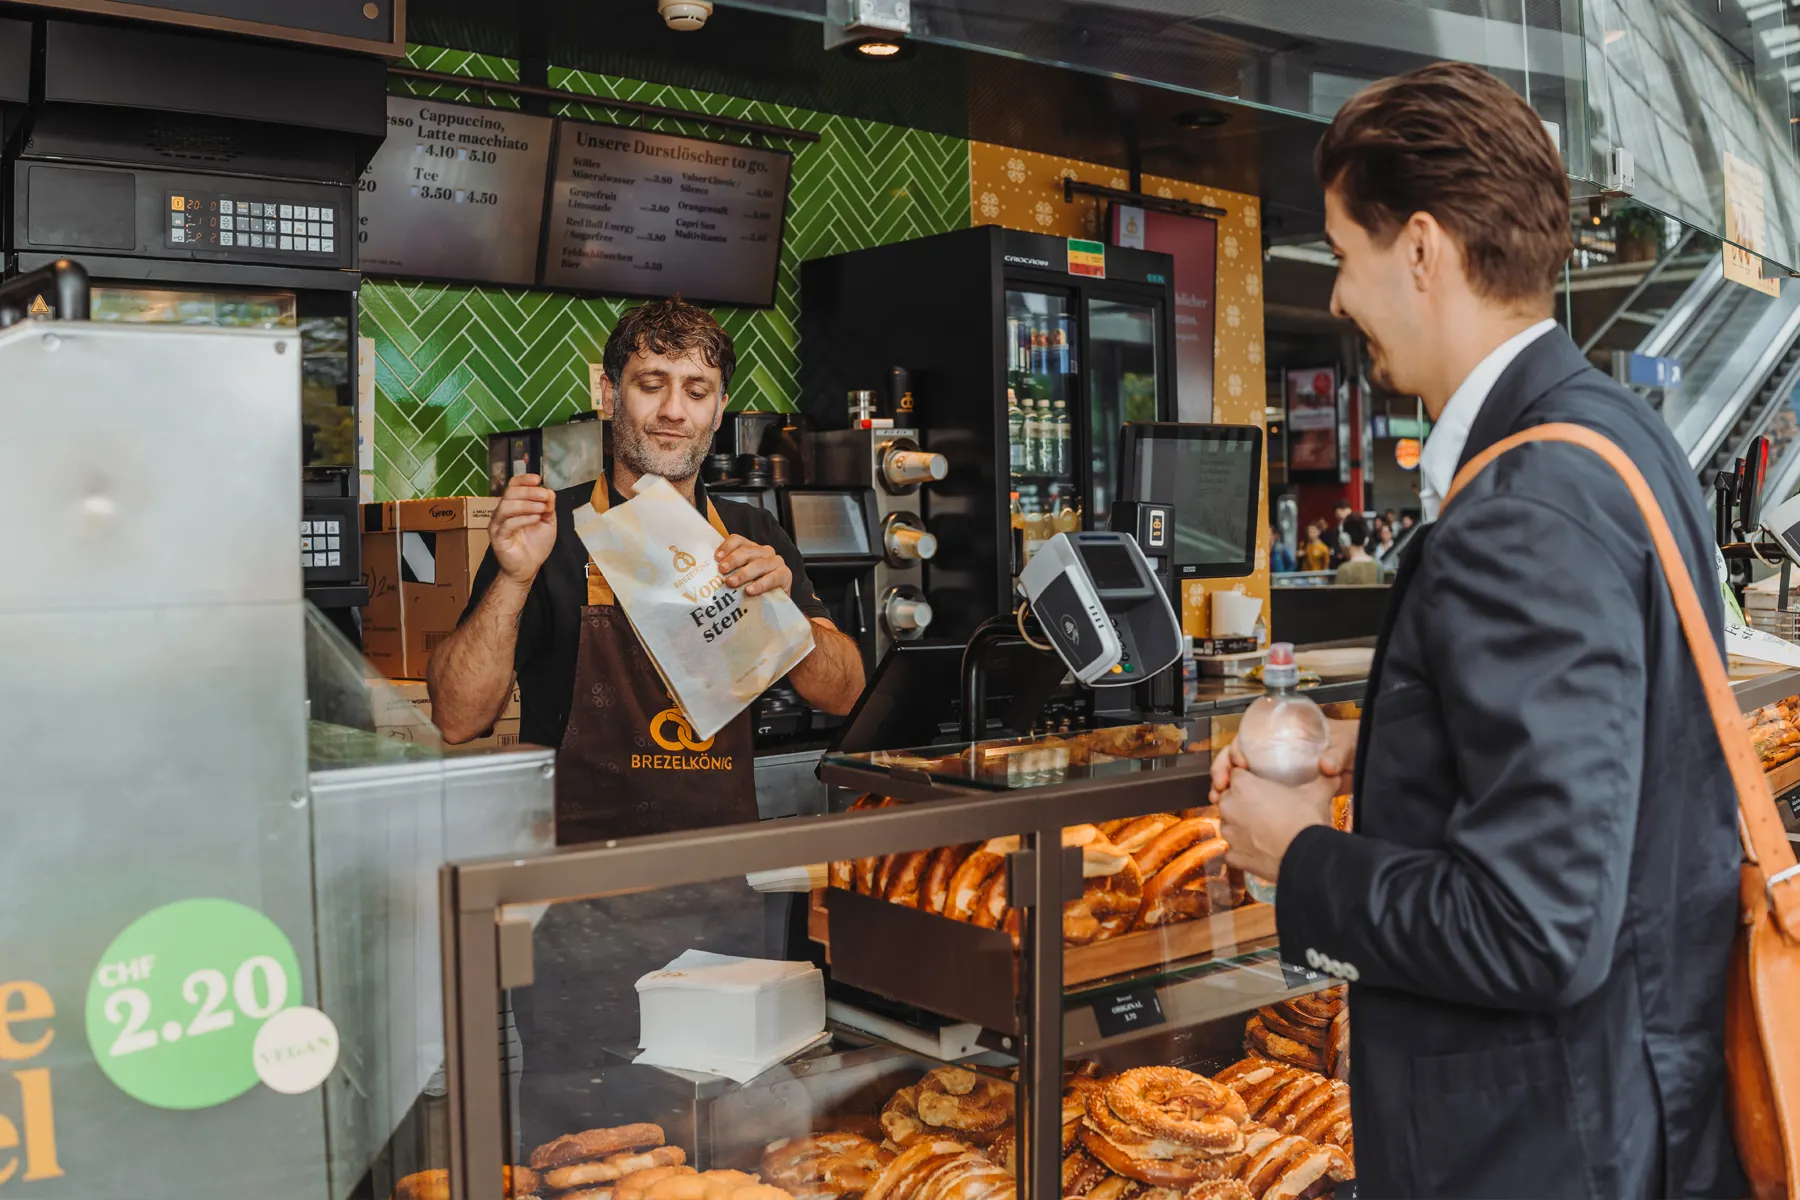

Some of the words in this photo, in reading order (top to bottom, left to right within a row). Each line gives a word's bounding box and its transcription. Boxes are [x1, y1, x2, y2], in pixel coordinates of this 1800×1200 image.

[419, 108, 505, 133] Cappuccino,
[417, 126, 456, 142] Latte
[458, 134, 529, 151] macchiato
[425, 144, 455, 159] 4.10
[469, 150, 496, 164] 5.10
[572, 157, 601, 168] Stilles
[576, 131, 631, 152] Unsere
[634, 139, 729, 167] Durstlöscher
[732, 157, 746, 169] to
[748, 160, 769, 175] go.
[413, 167, 440, 182] Tee
[572, 169, 636, 185] Mineralwasser
[682, 172, 707, 183] Valser
[421, 185, 453, 201] 3.50
[467, 190, 498, 205] 4.50
[569, 187, 617, 201] Grapefruit
[568, 199, 612, 212] Limonade
[566, 217, 583, 227] Red
[585, 219, 603, 229] Bull
[605, 222, 635, 234] Energy
[561, 259, 580, 270] Bier
[562, 247, 633, 262] Feldschlösschen
[682, 574, 726, 604] Vom
[690, 589, 738, 628] Fein-
[703, 607, 748, 643] sten.
[631, 752, 732, 770] BREZELKÖNIG
[98, 954, 156, 987] CHF
[104, 955, 287, 1057] 2.20
[259, 1035, 332, 1065] VEGAN
